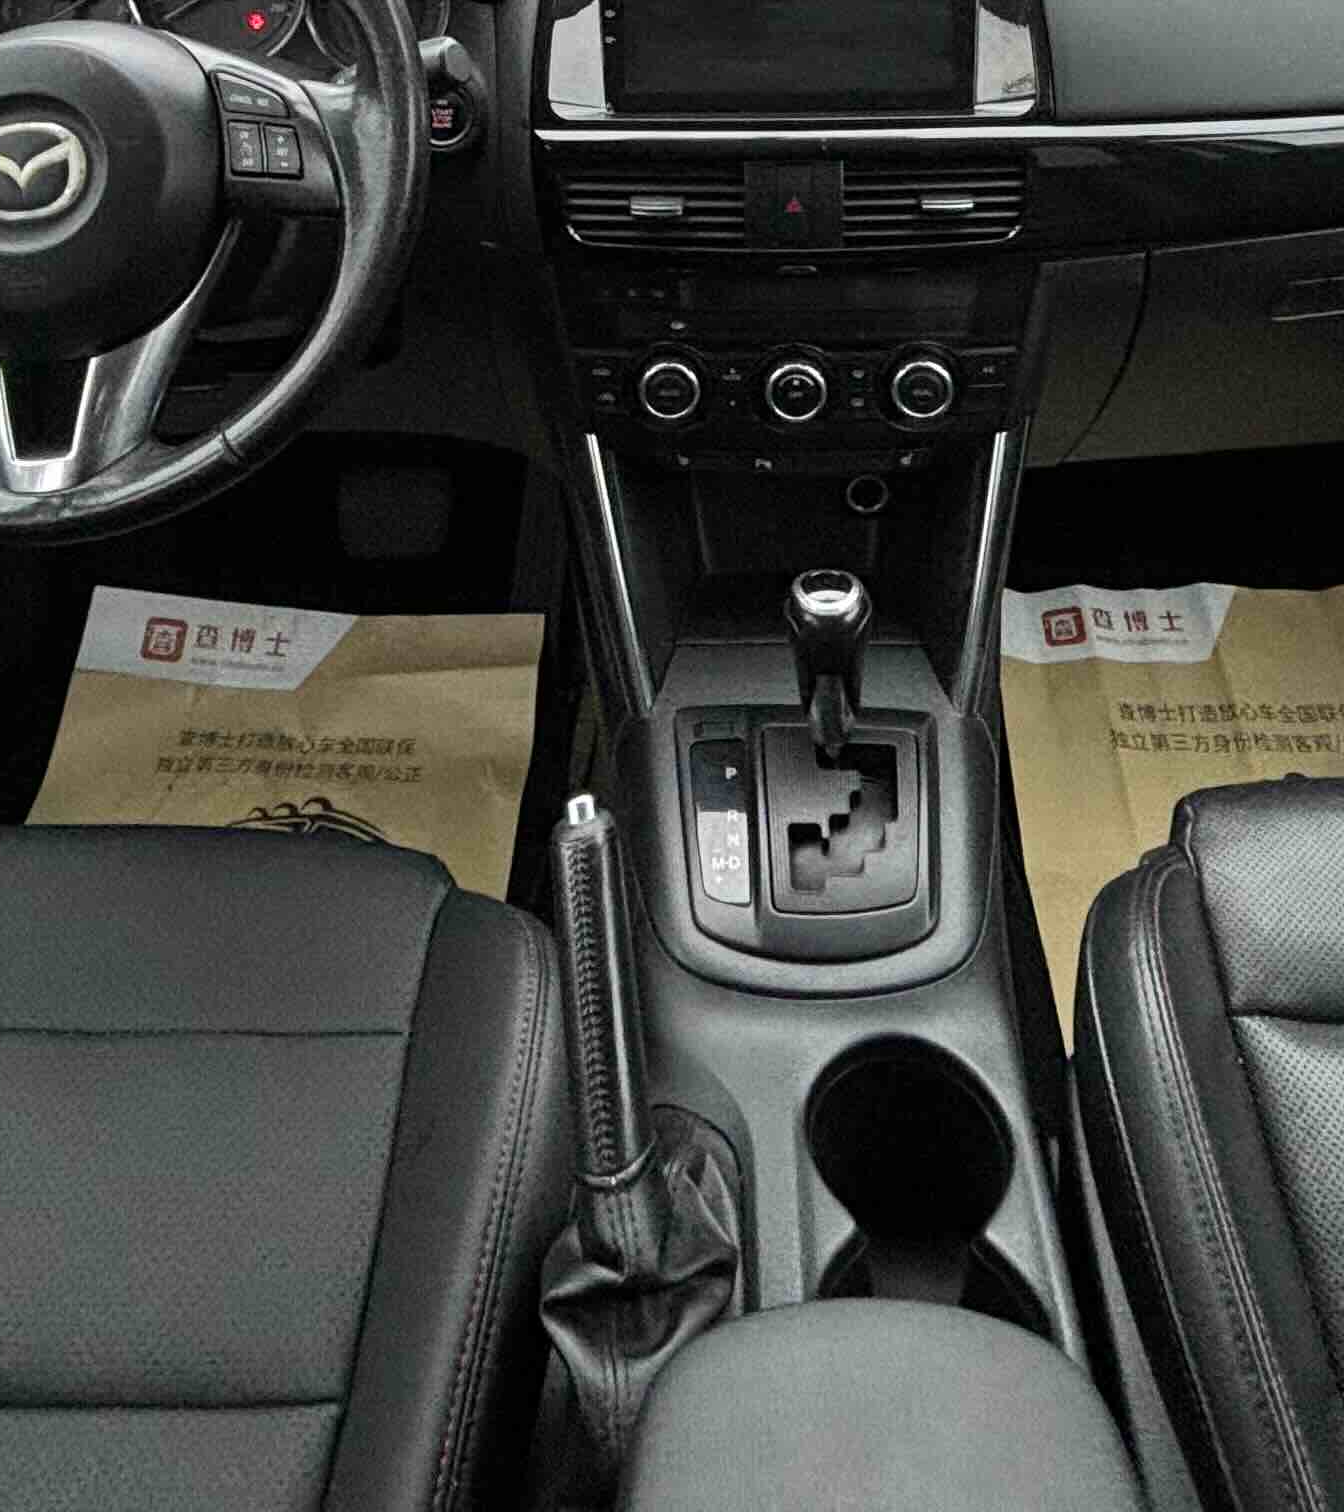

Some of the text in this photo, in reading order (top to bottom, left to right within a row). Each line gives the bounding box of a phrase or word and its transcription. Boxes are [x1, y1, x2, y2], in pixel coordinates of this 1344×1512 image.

[193, 623, 291, 657] 查博士
[725, 767, 737, 780] P
